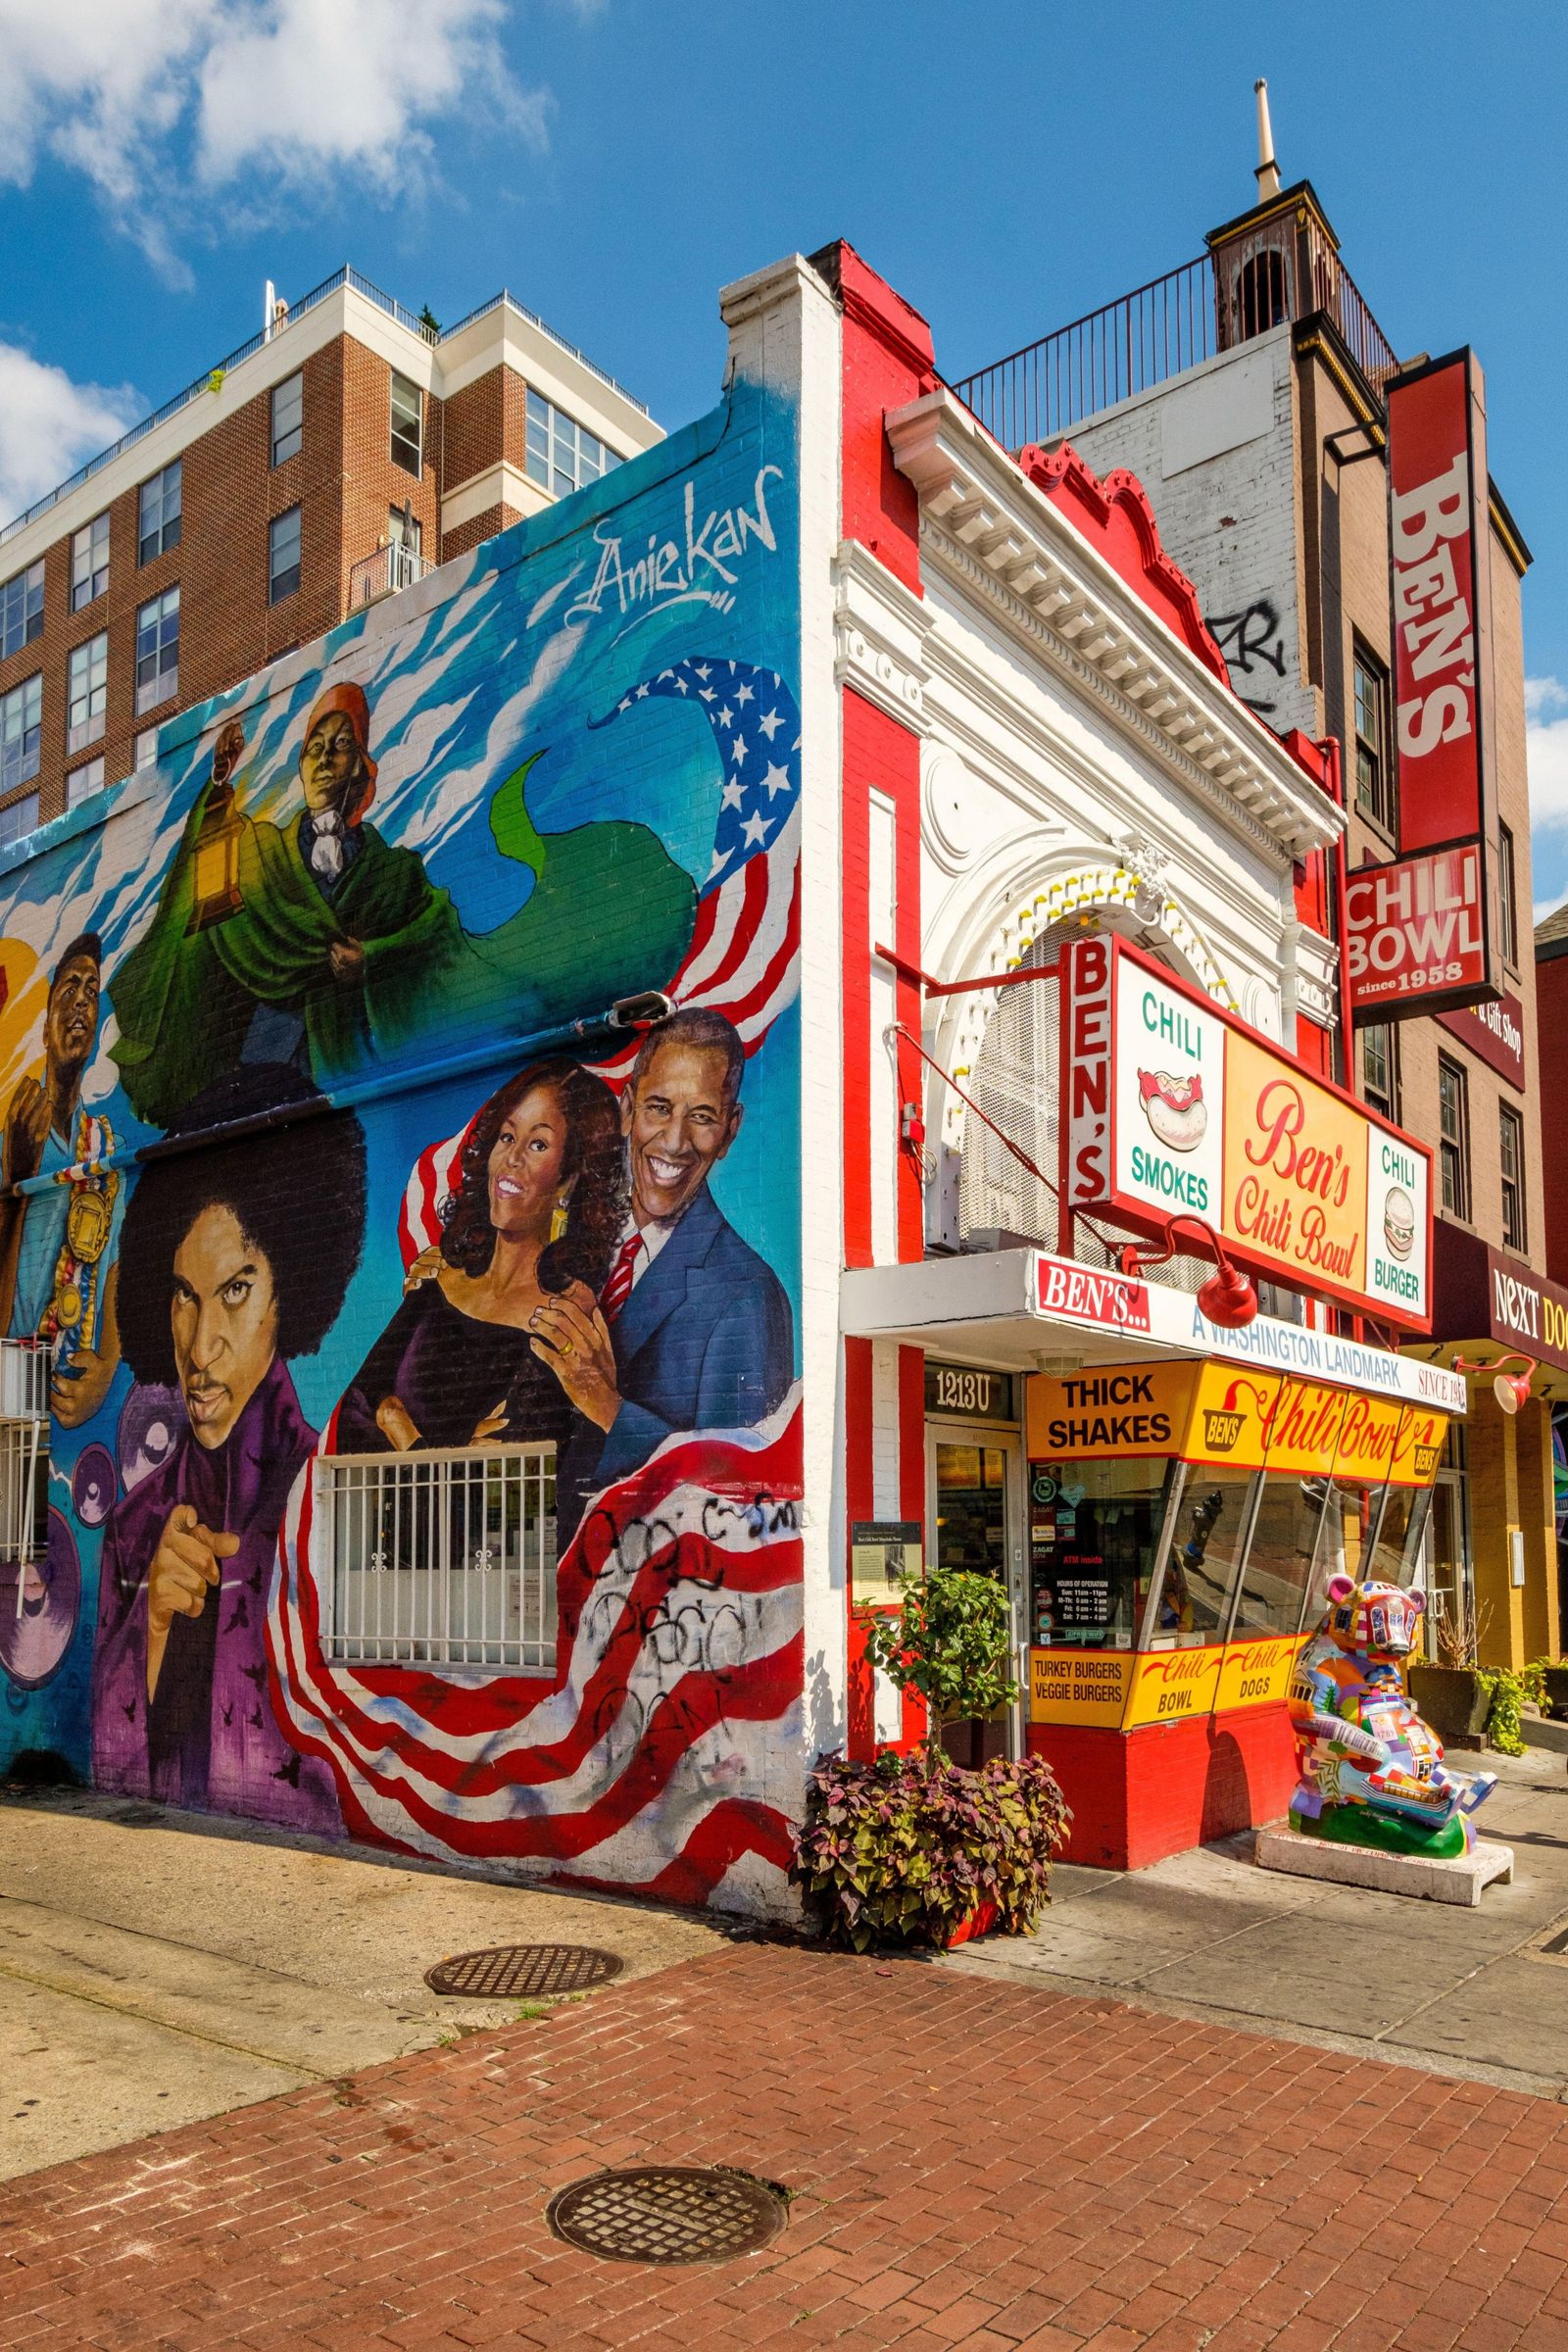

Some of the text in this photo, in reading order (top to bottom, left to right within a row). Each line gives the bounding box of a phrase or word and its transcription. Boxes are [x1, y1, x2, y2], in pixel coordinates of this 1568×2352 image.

[1392, 450, 1475, 759] BEN'S
[1346, 856, 1476, 931] CHILI
[1348, 910, 1483, 977] BOWL
[1357, 961, 1463, 995] since 1958
[1142, 991, 1201, 1061] CHILI
[1502, 1013, 1521, 1063] Shop
[1073, 941, 1108, 1199] BEN'S
[1245, 1079, 1350, 1207] Ben's
[1131, 1145, 1208, 1211] SMOKES
[1382, 1145, 1415, 1190] CHILI
[1235, 1175, 1359, 1279] Chili Bowl
[1374, 1258, 1419, 1302] BURGER
[1192, 1305, 1206, 1340] A
[1325, 1342, 1401, 1389] LANDMARK
[1543, 1297, 1568, 1354] DO
[1061, 1374, 1154, 1408] THICK
[1418, 1368, 1448, 1399] SINCE
[1048, 1413, 1171, 1448] SHAKES
[1206, 1416, 1240, 1445] BEN'S
[1257, 1380, 1414, 1463] Chili Bowl
[1035, 1660, 1122, 1681] TURKEY BURGERS
[1160, 1653, 1205, 1684] Chili
[1238, 1644, 1280, 1672] Chili
[1035, 1683, 1122, 1702] VEGGIE BURGERS
[1157, 1690, 1193, 1713] BOWL
[1239, 1677, 1270, 1698] DOGS
